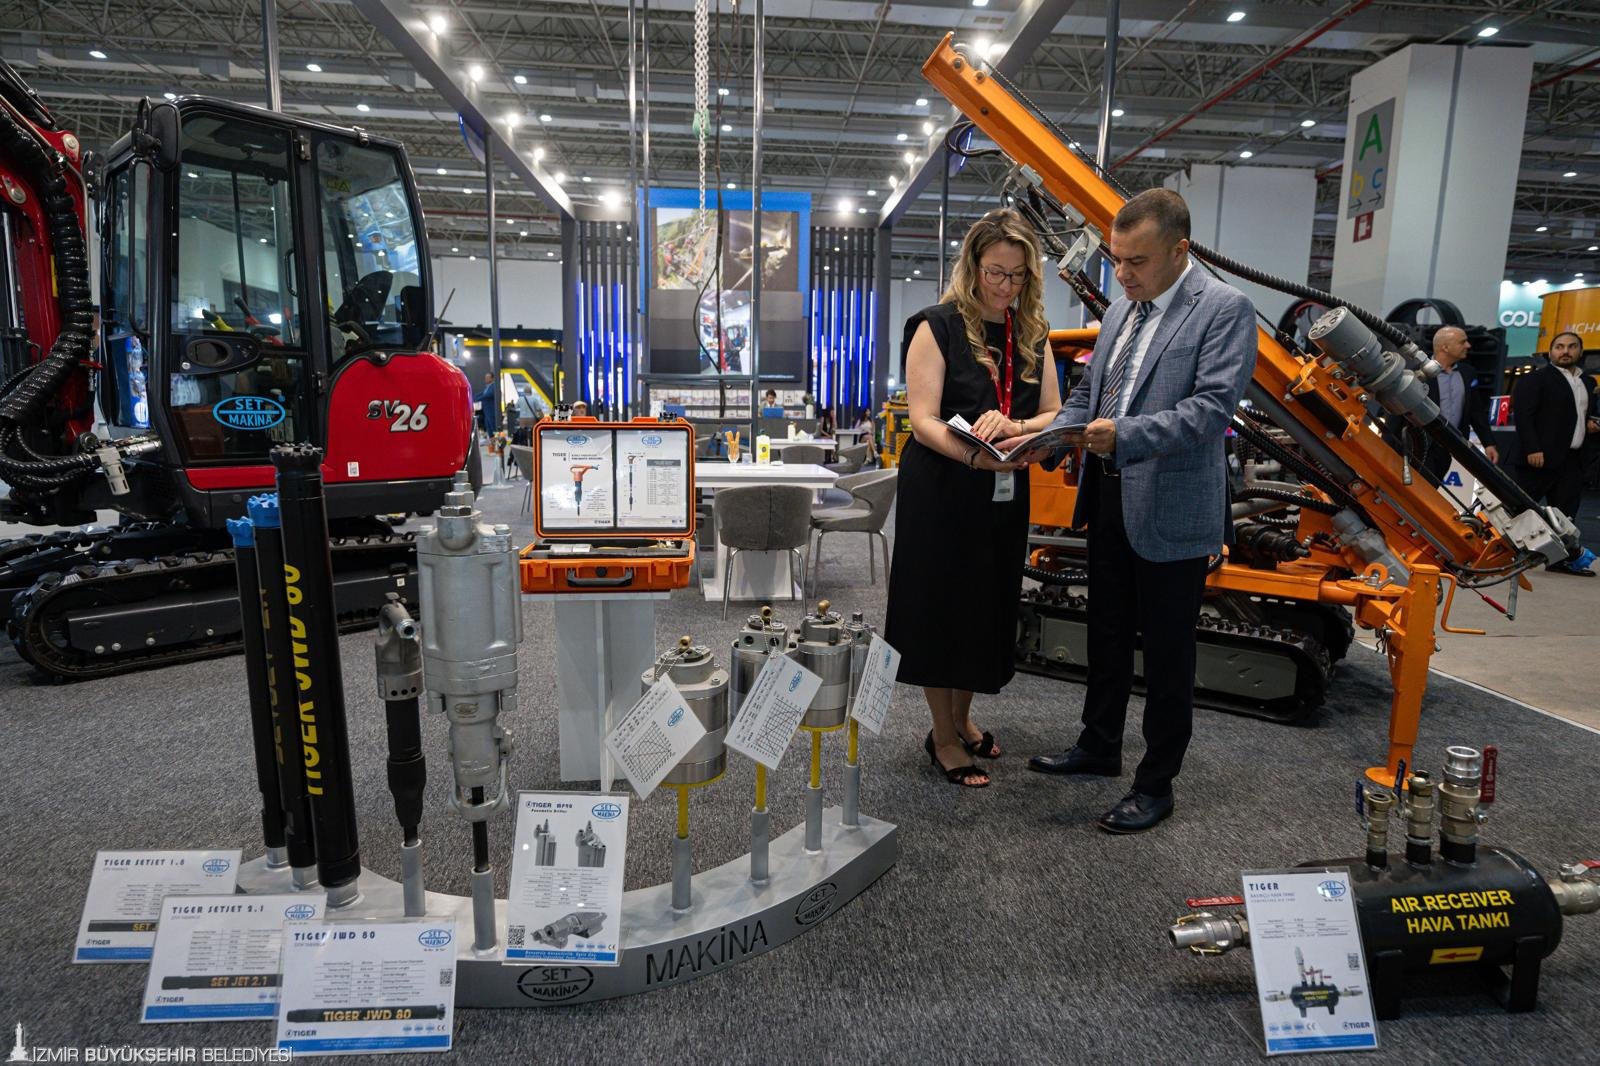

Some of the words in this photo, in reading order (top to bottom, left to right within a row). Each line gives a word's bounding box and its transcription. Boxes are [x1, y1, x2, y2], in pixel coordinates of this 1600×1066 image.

[1360, 113, 1382, 161] A
[235, 399, 264, 410] SET
[1391, 897, 1422, 913] AIR
[1423, 890, 1515, 911] RECEIVER
[172, 906, 203, 914] TIGER
[208, 905, 242, 913] SETJET
[133, 923, 150, 931] SET
[1406, 916, 1455, 934] HAVA
[1456, 912, 1510, 930] TANKI
[333, 931, 356, 940] JWD
[362, 931, 376, 939] 80
[646, 920, 768, 984] MAKİNA
[542, 968, 572, 981] SET
[210, 977, 229, 987] SET
[231, 977, 248, 986] JET
[251, 976, 268, 986] 2.1
[323, 1011, 360, 1021] TIGER
[363, 1010, 392, 1020] JWD
[395, 1009, 412, 1019] 80
